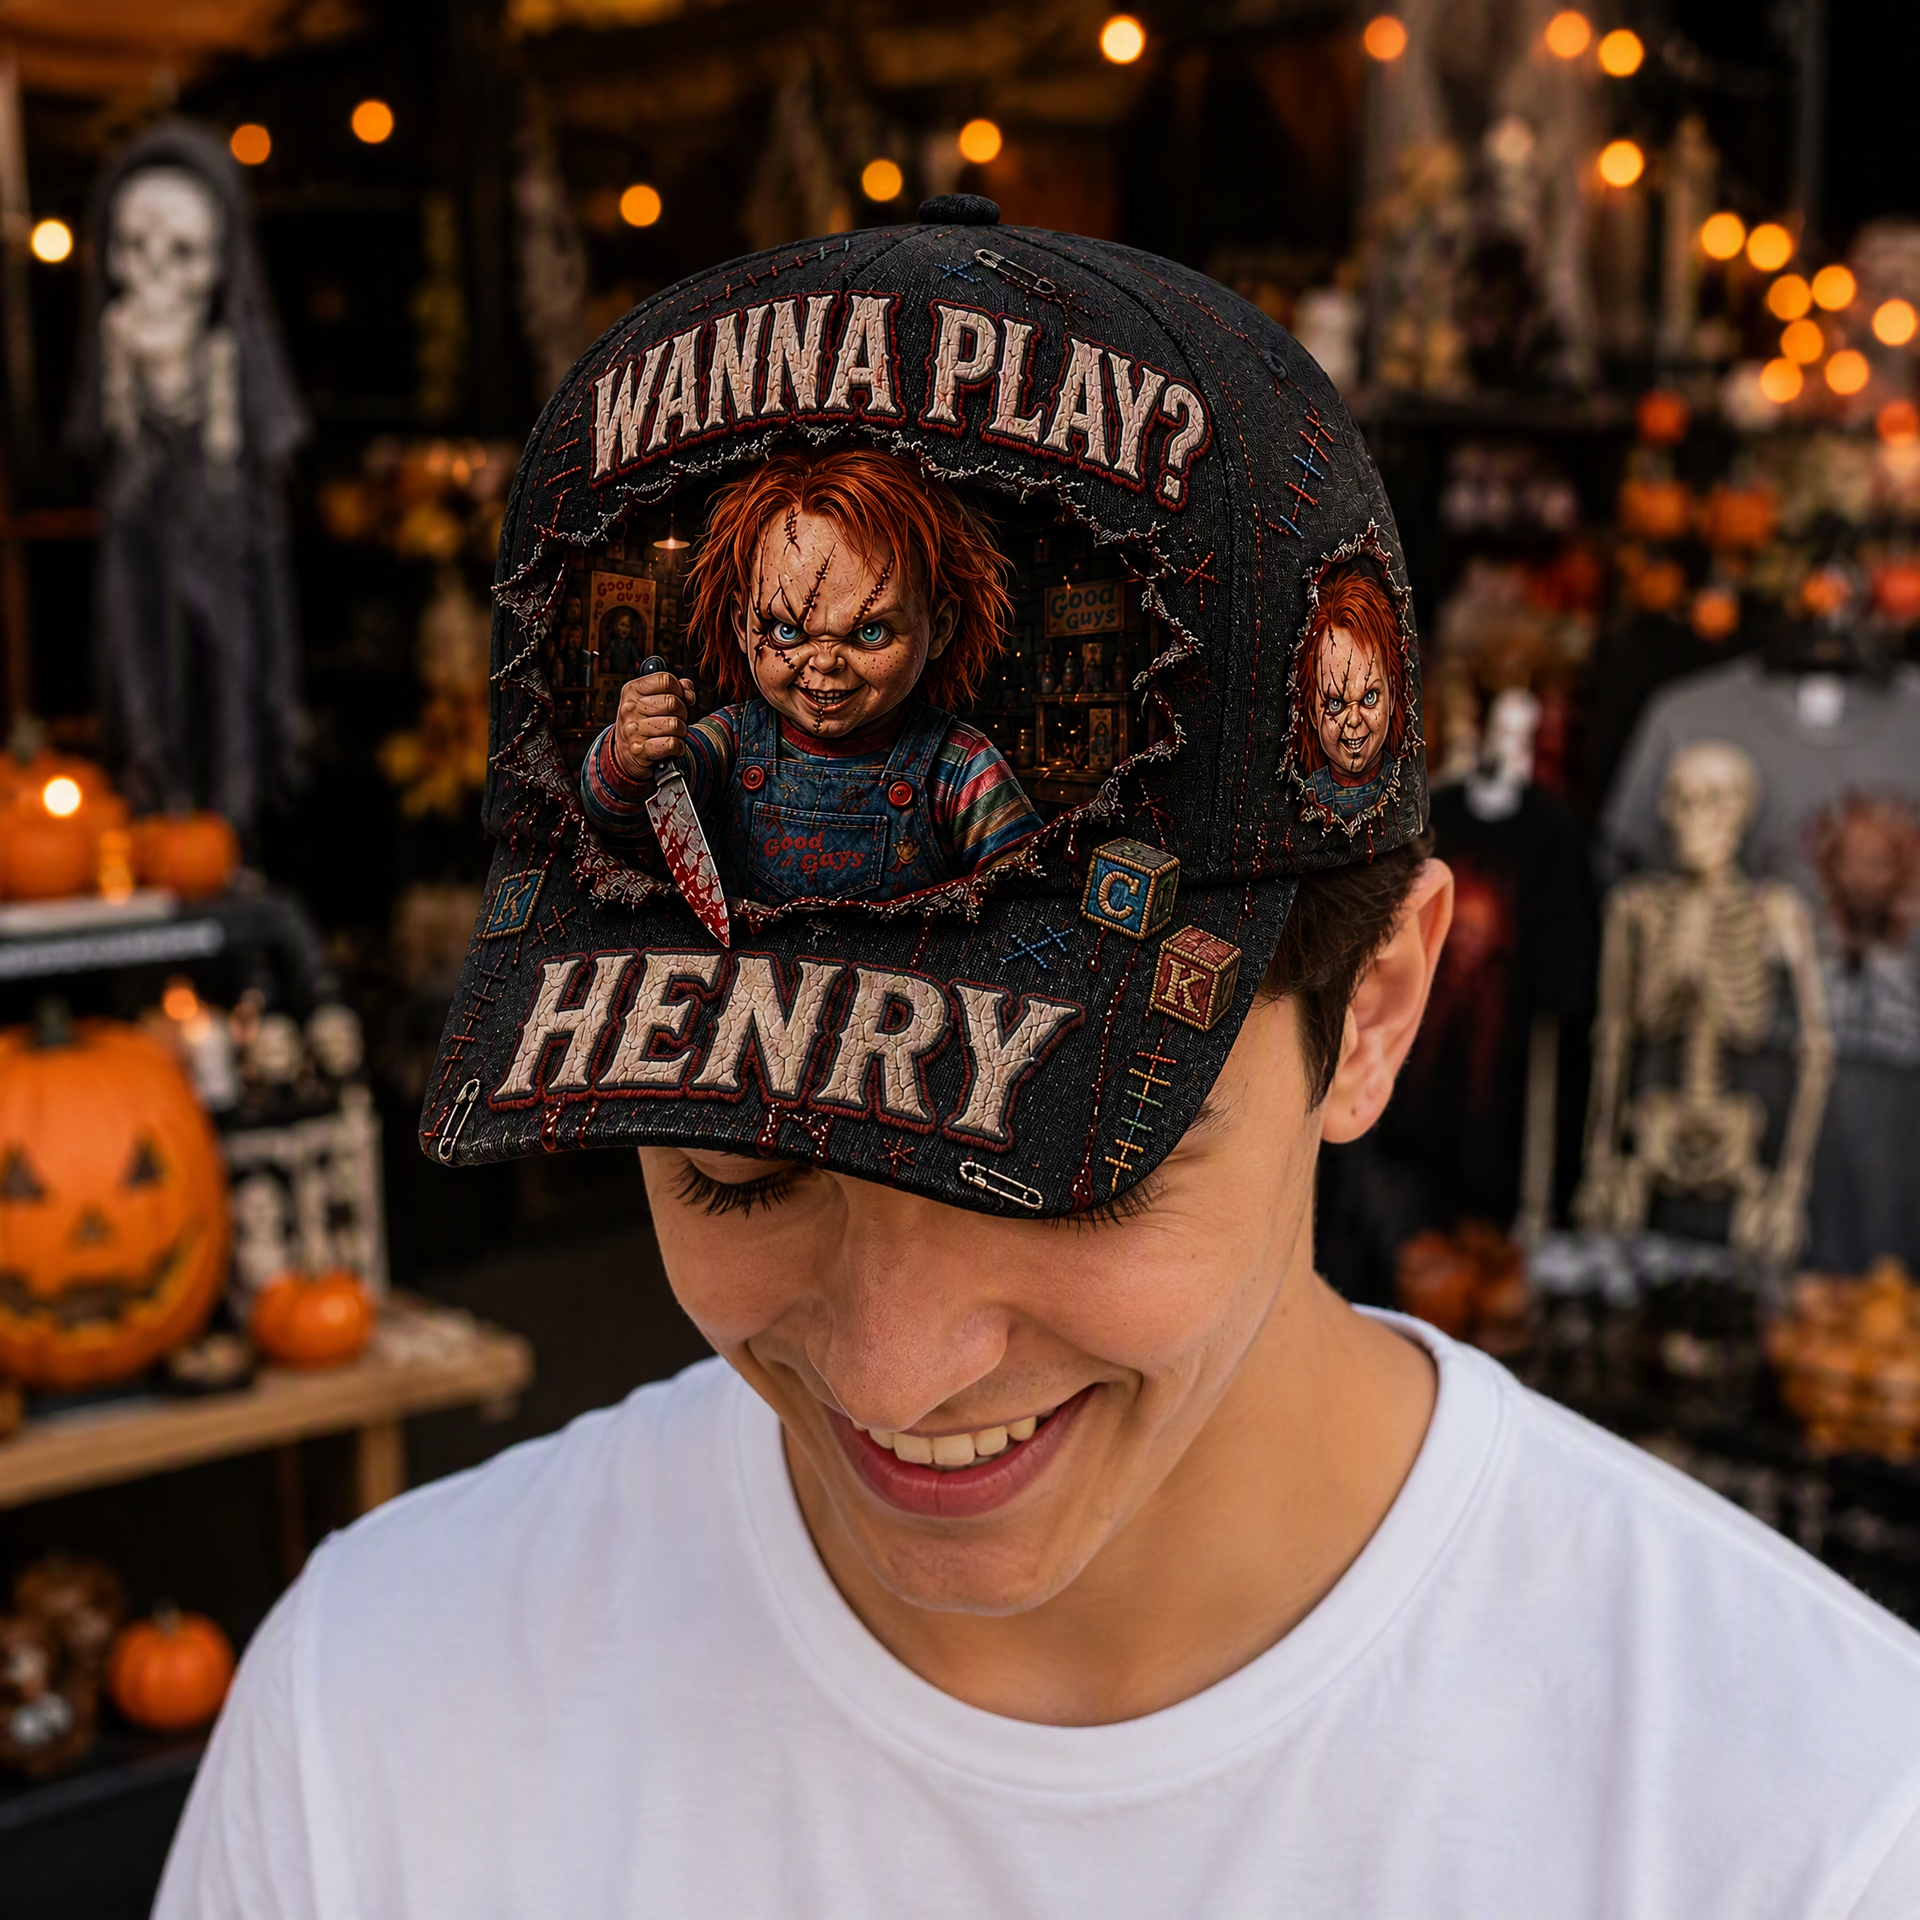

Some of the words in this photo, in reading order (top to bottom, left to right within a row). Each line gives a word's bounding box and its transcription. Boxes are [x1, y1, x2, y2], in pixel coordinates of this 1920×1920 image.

[591, 292, 905, 483] WANNA
[920, 300, 1211, 505] PLAY?
[1051, 584, 1114, 619] Good
[1066, 609, 1116, 630] Guys
[763, 831, 824, 858] Good
[494, 882, 532, 925] K
[1098, 870, 1140, 920] C
[1161, 959, 1207, 1017] K
[490, 948, 1082, 1147] HENRY
